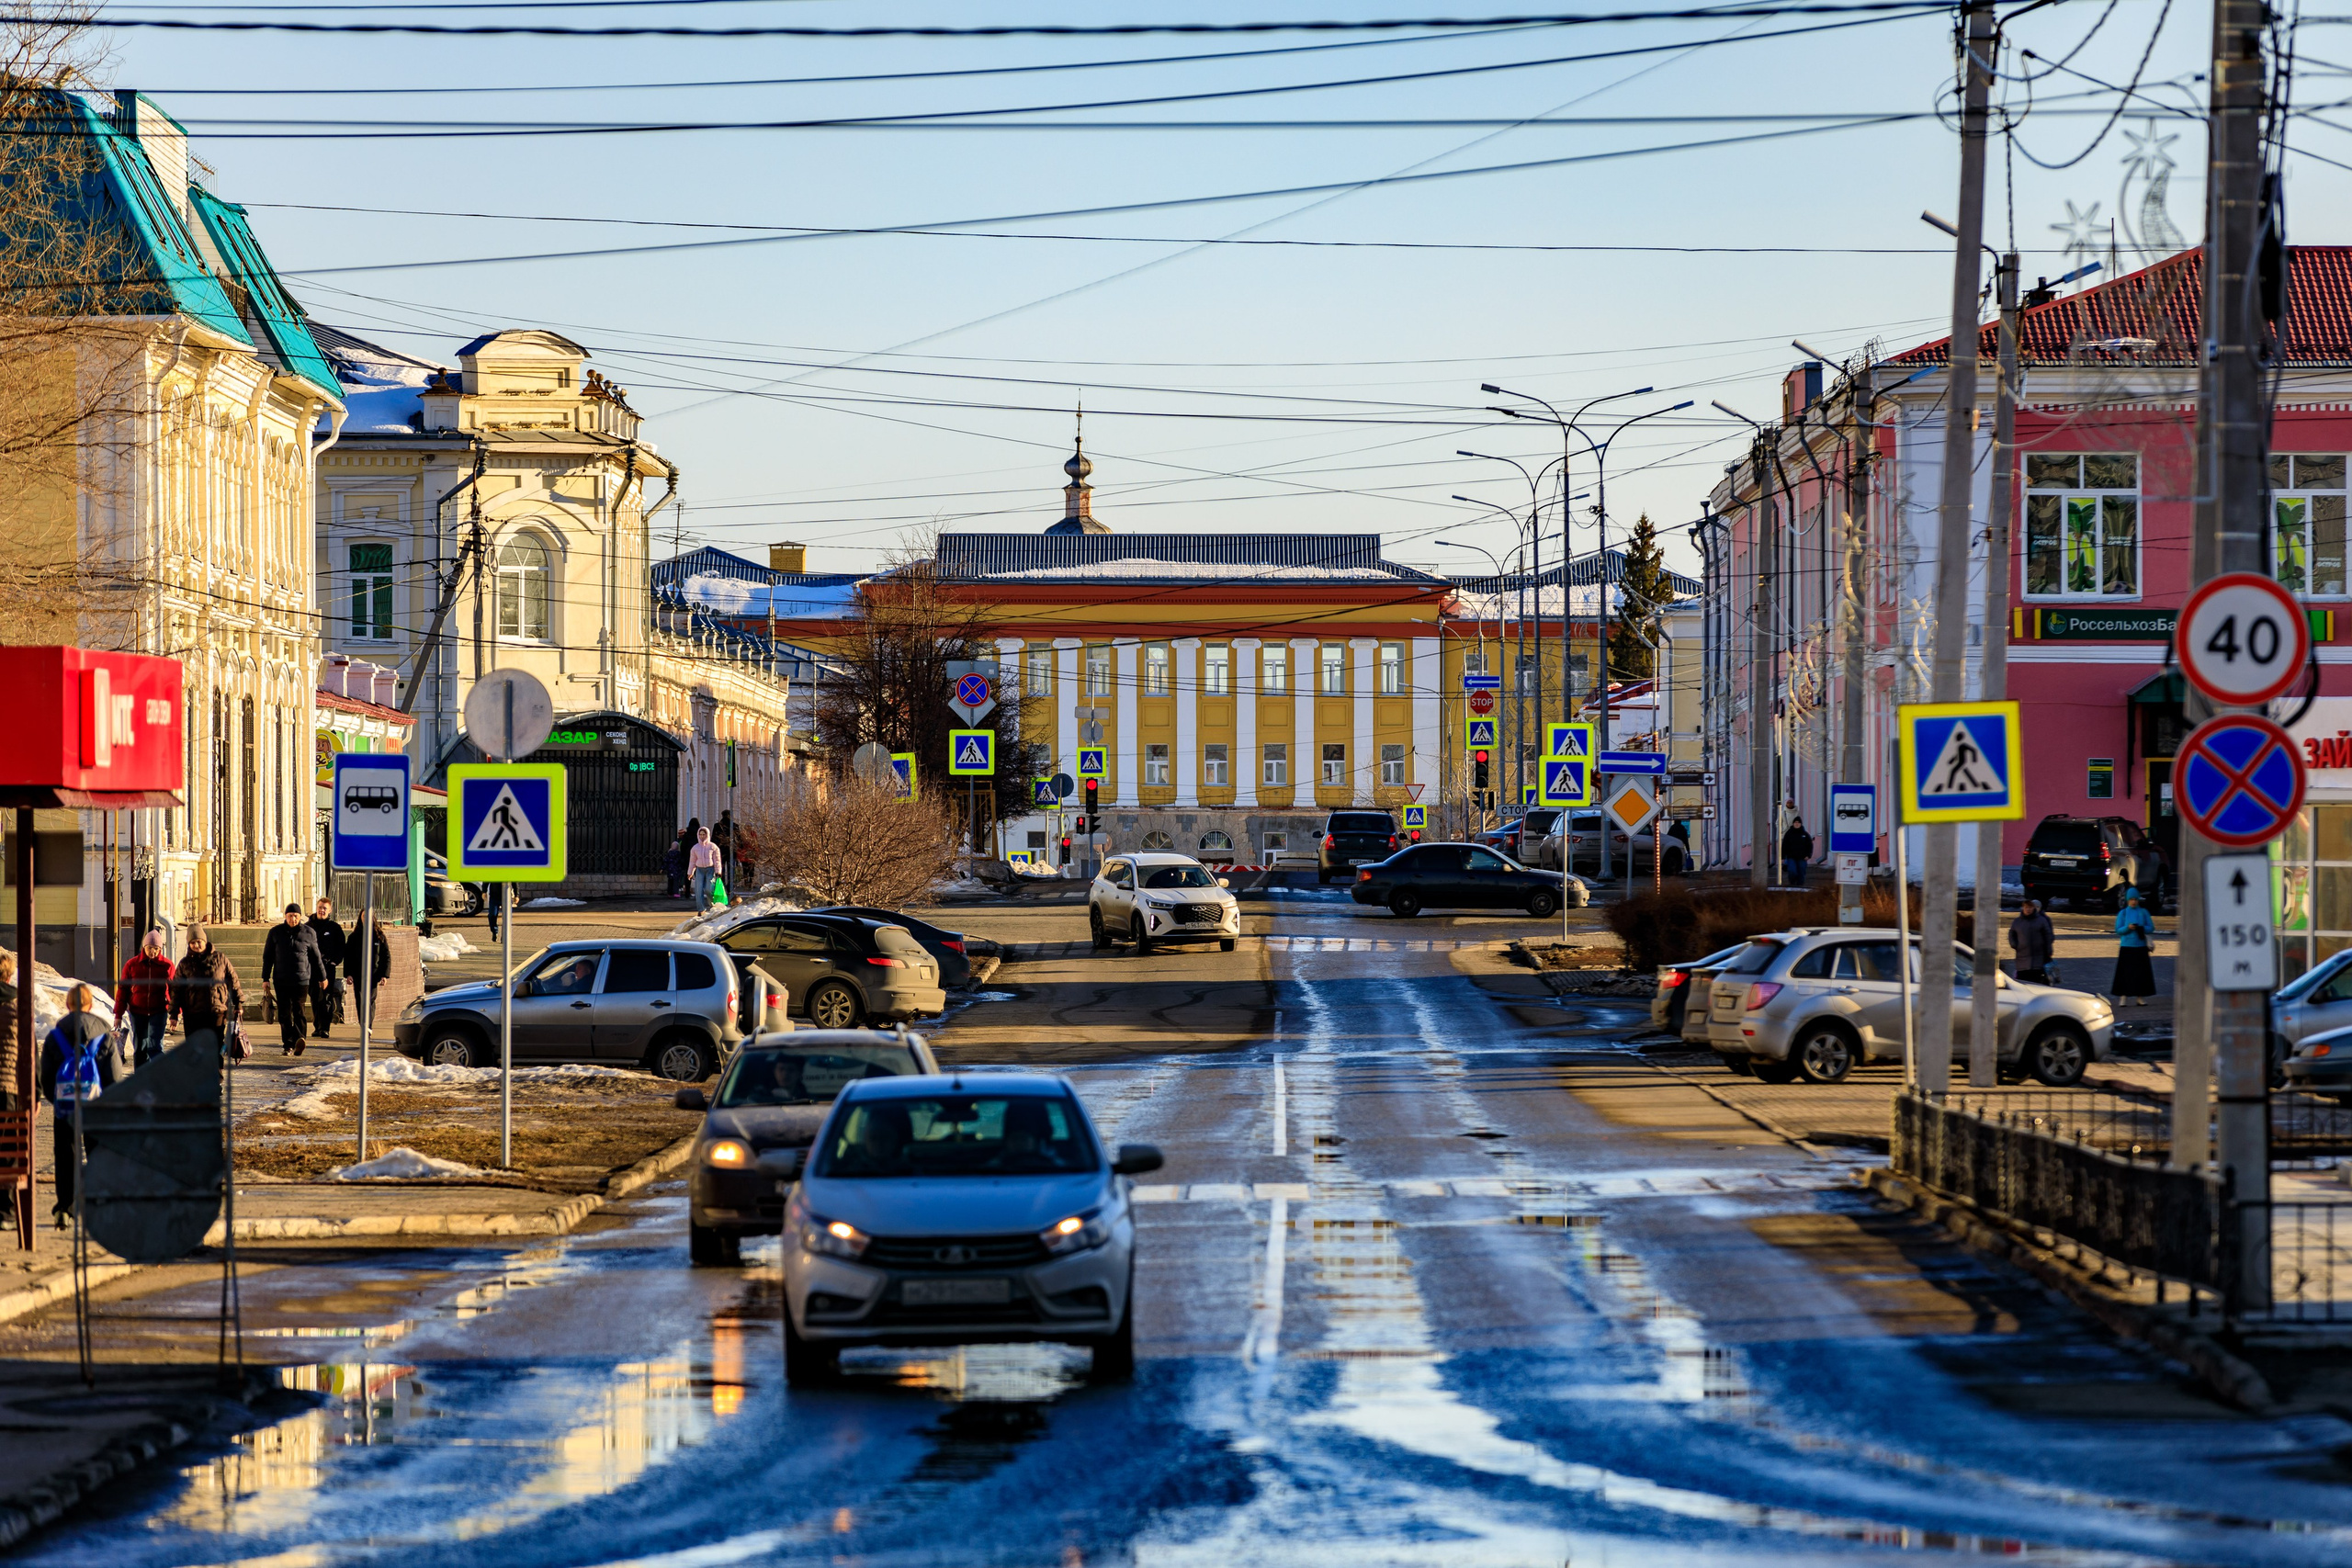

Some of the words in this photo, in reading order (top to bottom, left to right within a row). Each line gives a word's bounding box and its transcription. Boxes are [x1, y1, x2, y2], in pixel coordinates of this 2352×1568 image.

[2069, 617, 2177, 632] РоссельхозБа
[2206, 615, 2282, 665] 40
[1471, 698, 1493, 706] STOP
[544, 731, 598, 744] АЗАР
[2304, 730, 2352, 769] ЗАЙ
[1501, 806, 1529, 815] СТОП
[2217, 924, 2267, 947] 150
